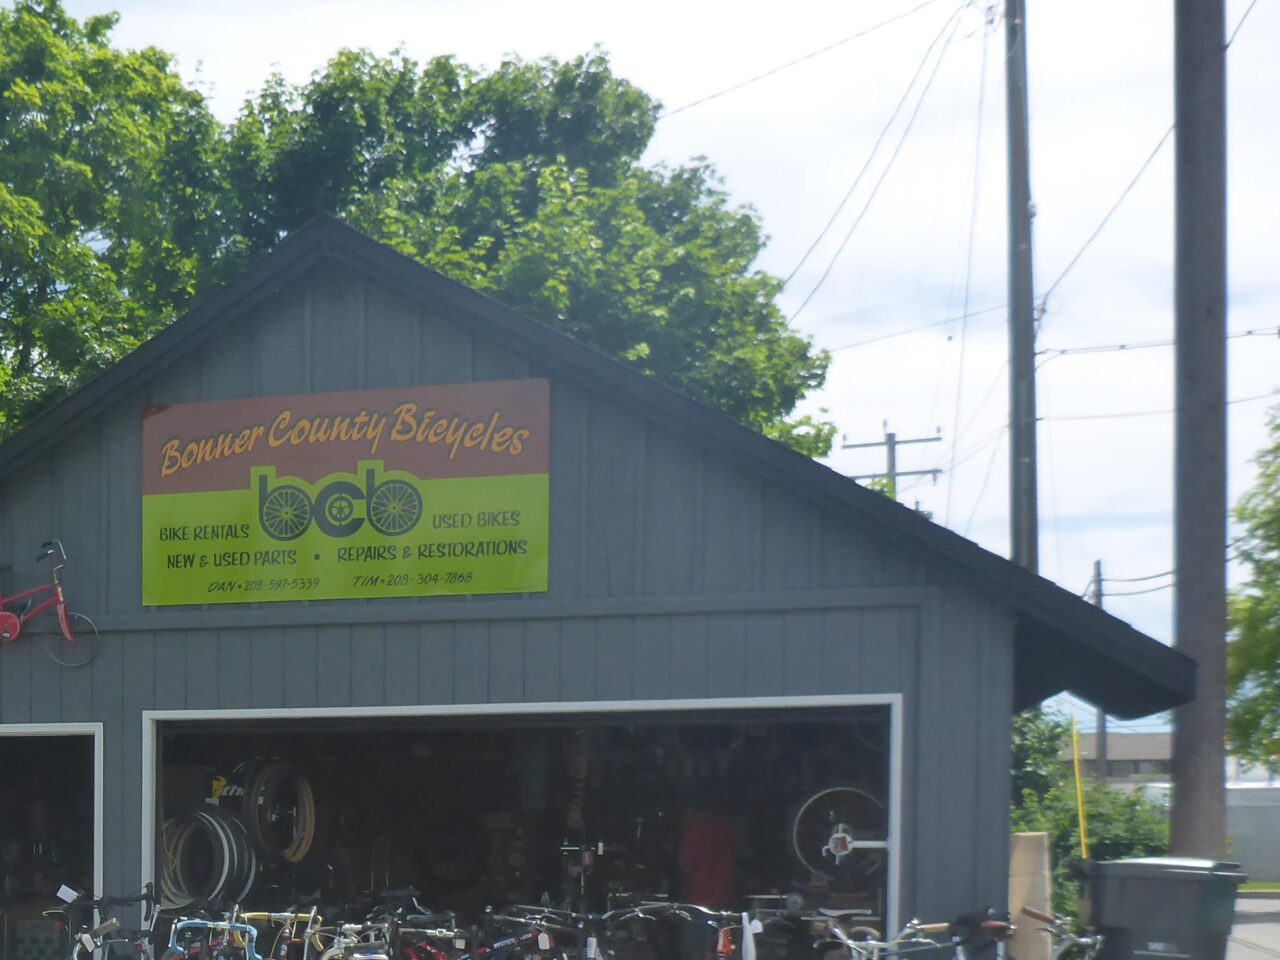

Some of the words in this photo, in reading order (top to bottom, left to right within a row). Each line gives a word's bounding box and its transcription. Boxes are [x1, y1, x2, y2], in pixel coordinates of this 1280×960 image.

[160, 425, 264, 477] Bonner
[268, 410, 386, 455] County
[391, 402, 530, 460] Bicycles
[258, 468, 423, 541] bcb
[432, 513, 472, 529] USED
[477, 510, 521, 528] BIKES
[159, 526, 189, 542] BIKE
[193, 524, 250, 541] RENTALS
[167, 554, 195, 569] NEW
[199, 554, 208, 568] &
[213, 551, 250, 568] USED
[254, 549, 297, 566] PARTS
[337, 545, 397, 563] REPAIRS
[402, 546, 412, 560] &
[417, 540, 528, 560] RESTORATIONS
[352, 575, 379, 587] TIM
